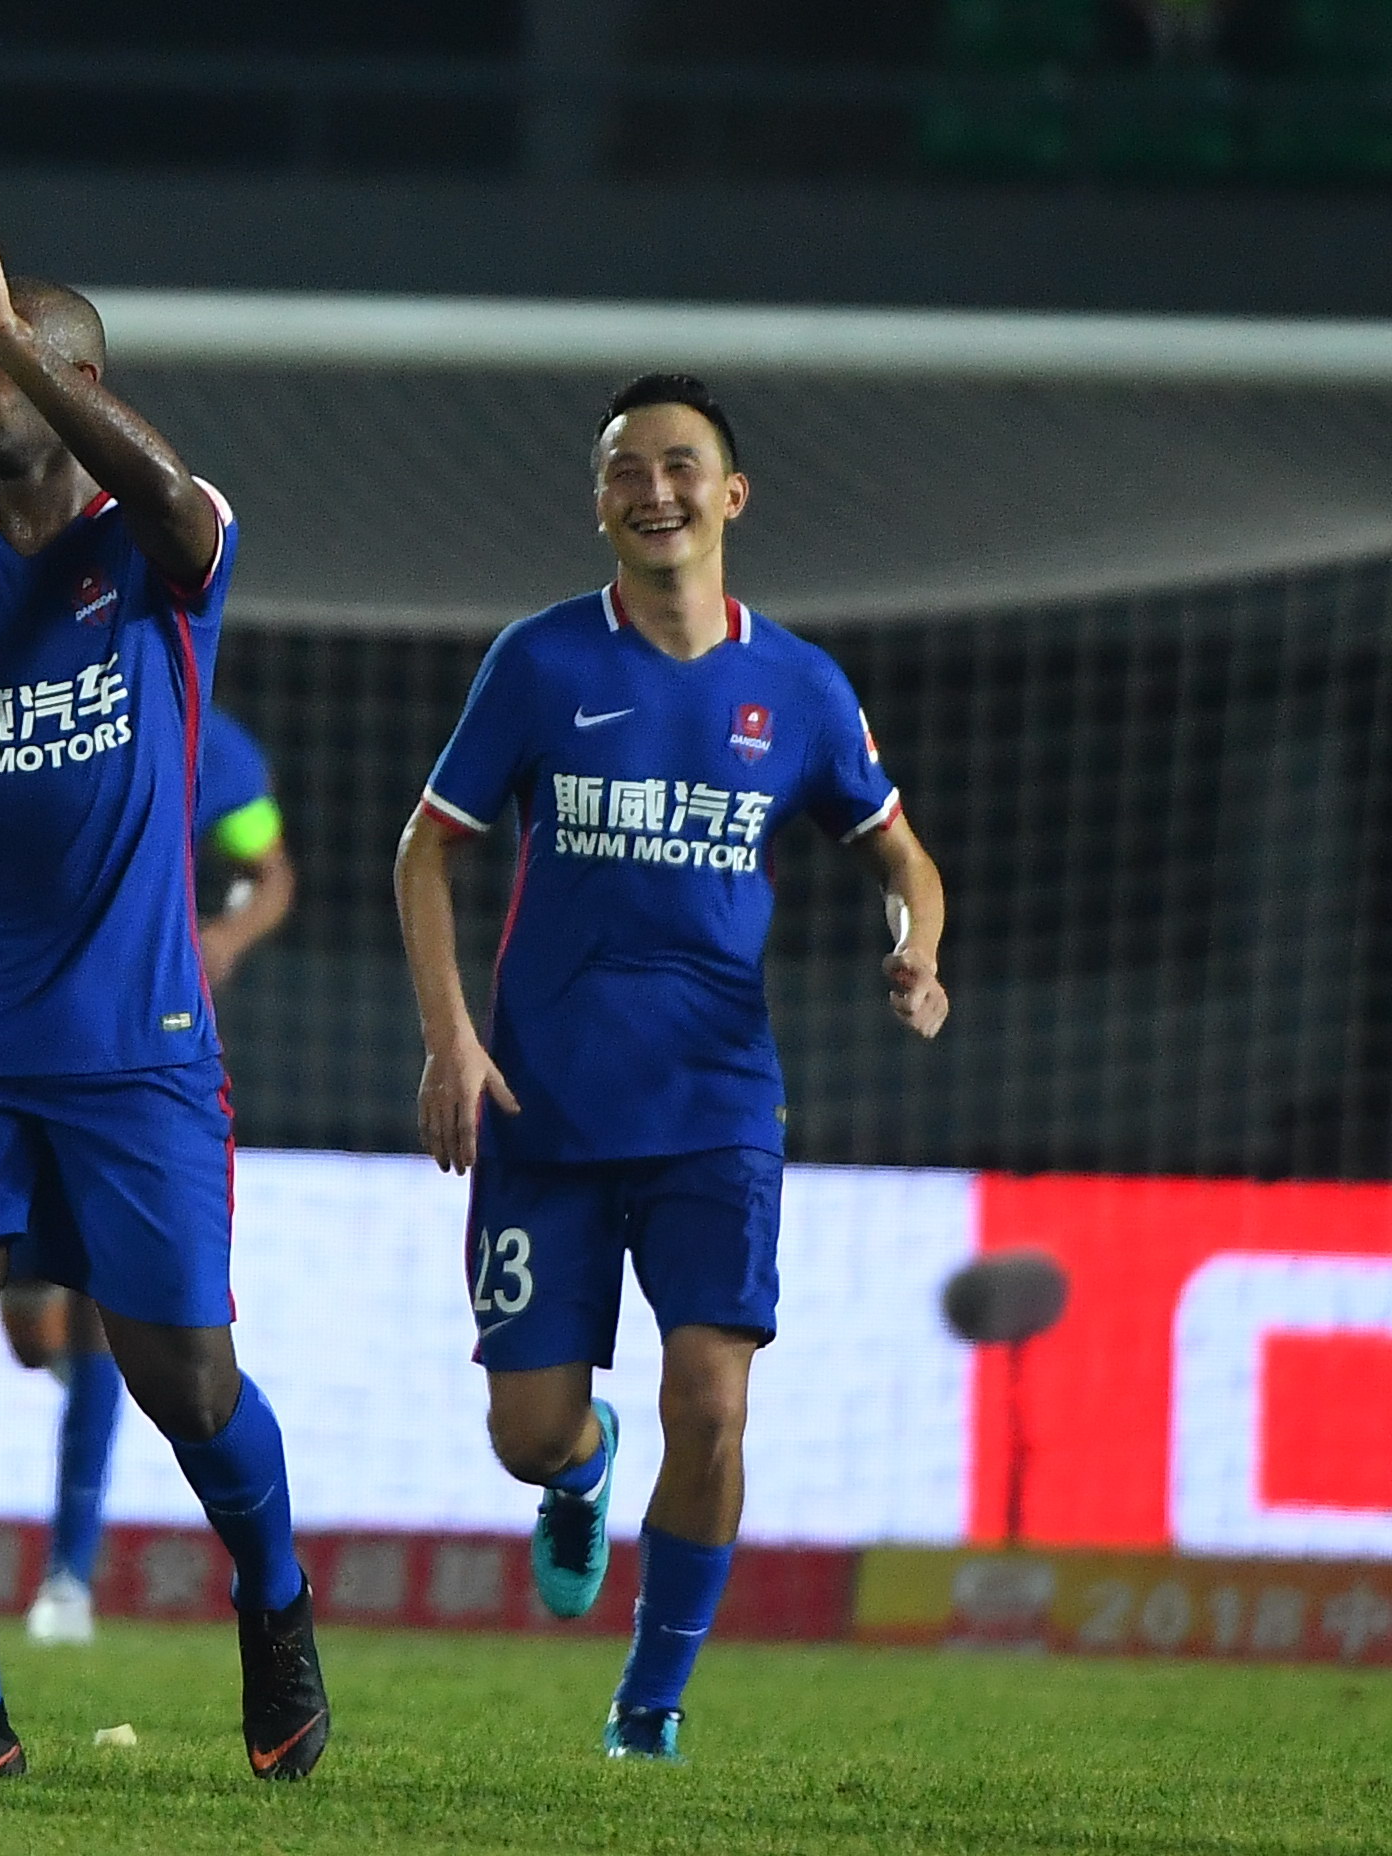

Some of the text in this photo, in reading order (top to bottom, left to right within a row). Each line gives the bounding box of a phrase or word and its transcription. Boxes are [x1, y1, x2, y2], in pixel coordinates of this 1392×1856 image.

[553, 773, 774, 843] 斯威汽车
[555, 827, 757, 873] SWM MOTORS
[474, 1226, 533, 1313] 23
